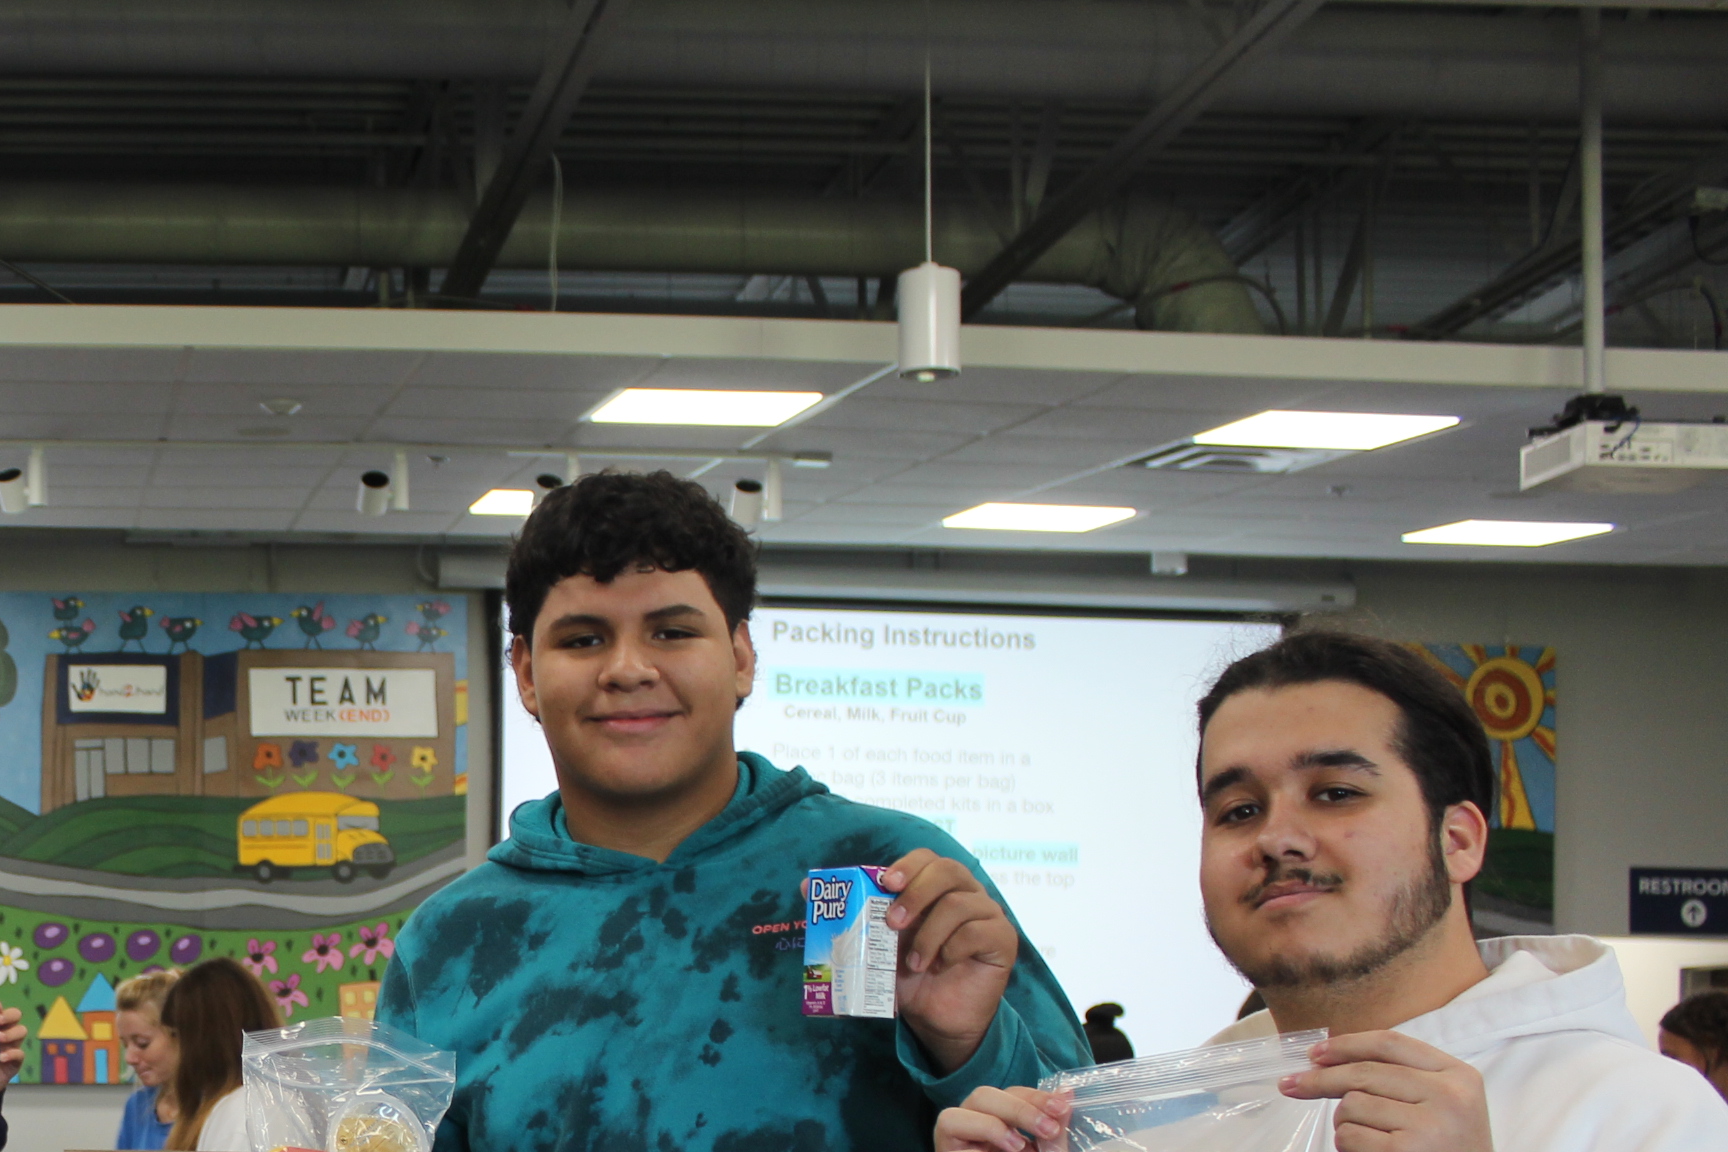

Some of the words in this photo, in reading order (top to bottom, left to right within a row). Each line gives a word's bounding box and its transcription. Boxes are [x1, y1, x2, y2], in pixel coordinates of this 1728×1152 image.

[772, 620, 874, 650] Packing
[883, 624, 1036, 650] Instructions
[285, 676, 388, 707] TEAM
[776, 674, 898, 698] Breakfast
[907, 677, 983, 700] Packs
[784, 705, 841, 722] Cereal,
[846, 707, 884, 723] Milk,
[890, 707, 928, 723] Fruit
[933, 709, 966, 726] Cup
[773, 743, 820, 759] Place
[842, 745, 859, 761] of
[865, 746, 906, 762] each
[912, 747, 951, 763] food
[958, 748, 994, 765] item
[1000, 750, 1015, 766] in
[1021, 756, 1031, 766] a
[833, 769, 865, 789] bag
[872, 771, 886, 790] (3
[892, 772, 938, 788] items
[944, 775, 971, 793] per
[978, 774, 1016, 793] bag)
[951, 796, 980, 811] kits
[987, 797, 1001, 812] in
[1007, 803, 1017, 813] a
[1023, 798, 1054, 814] box
[1042, 847, 1079, 862] wall
[811, 876, 853, 902] Dairy
[1014, 869, 1039, 885] the
[1045, 871, 1074, 889] top
[812, 900, 846, 924] Pure
[752, 923, 790, 935] OPEN
